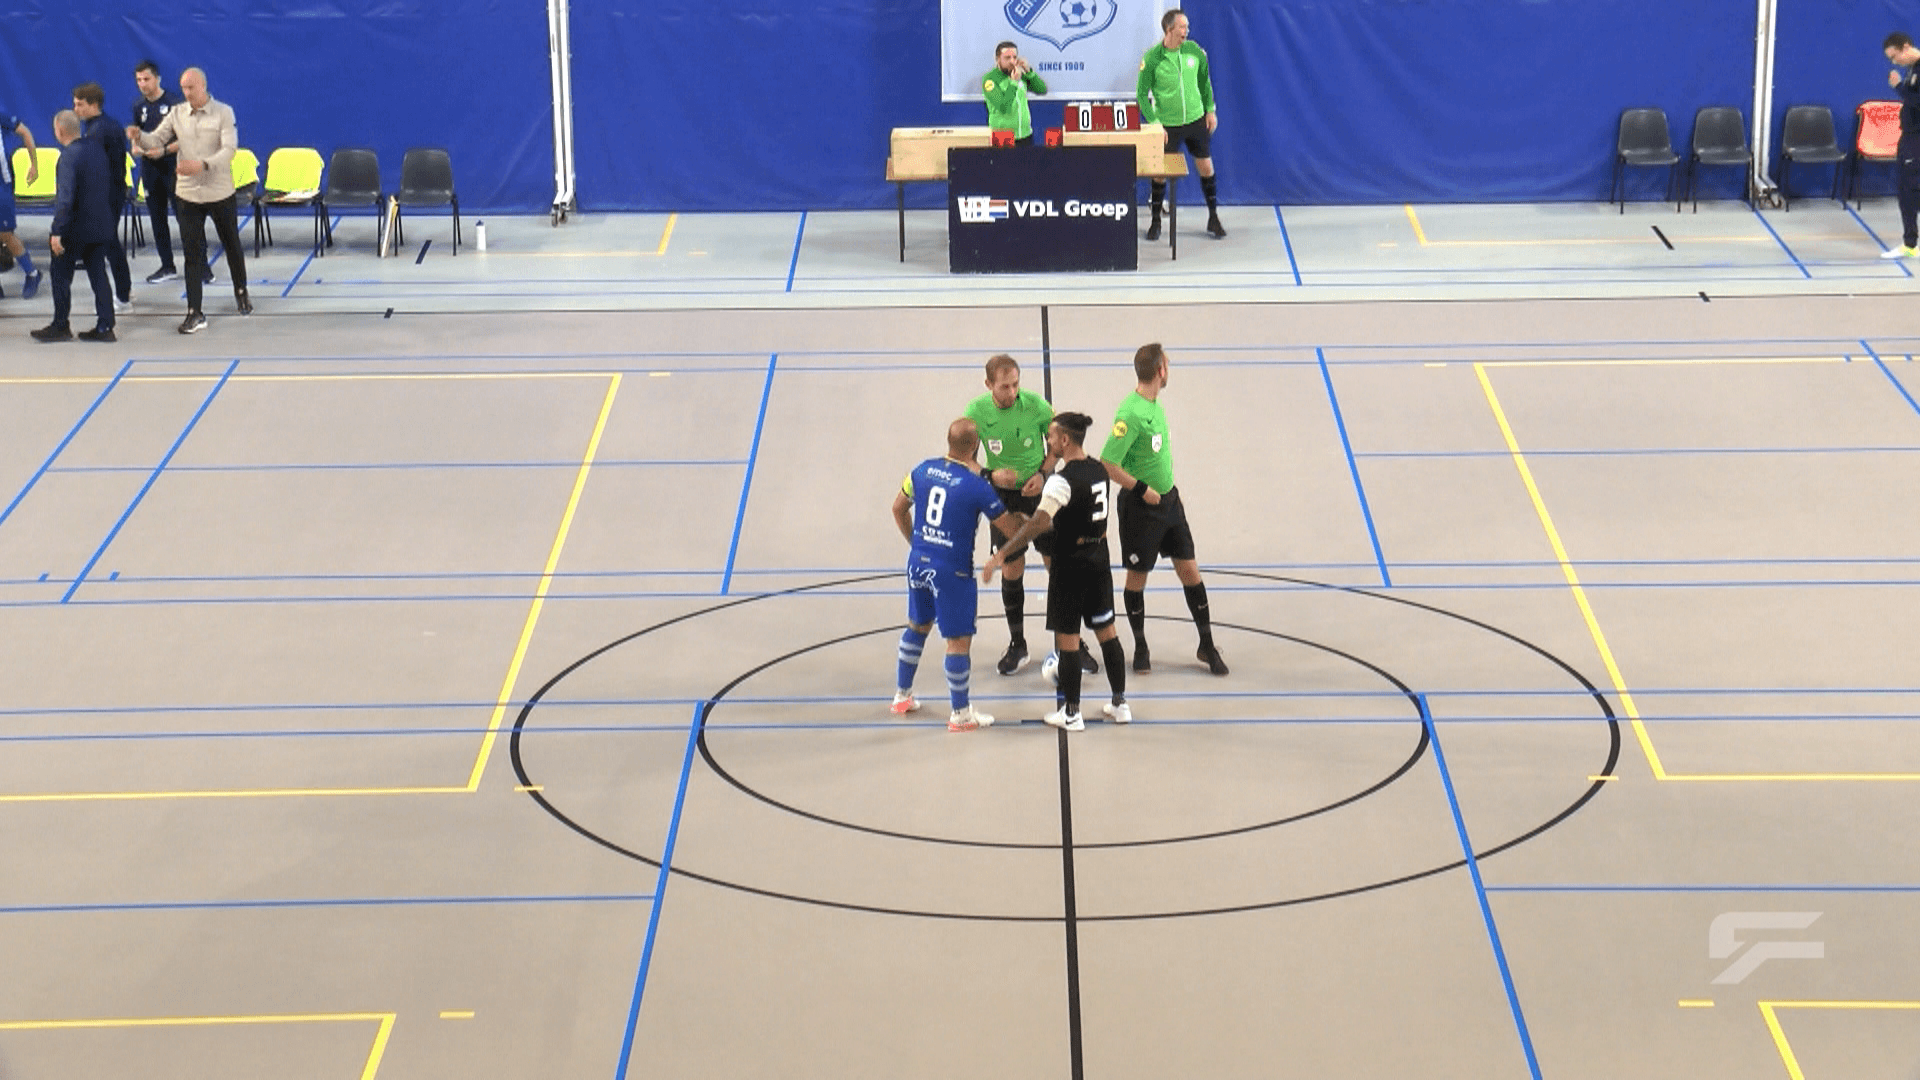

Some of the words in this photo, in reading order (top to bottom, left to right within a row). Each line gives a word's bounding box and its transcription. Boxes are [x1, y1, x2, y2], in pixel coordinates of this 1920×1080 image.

[1039, 62, 1062, 71] SINCE
[1081, 109, 1090, 128] 0
[1116, 109, 1125, 128] 0
[1013, 200, 1060, 217] VDL
[1064, 199, 1129, 221] Groep
[925, 485, 947, 527] 8
[1091, 481, 1108, 522] 3
